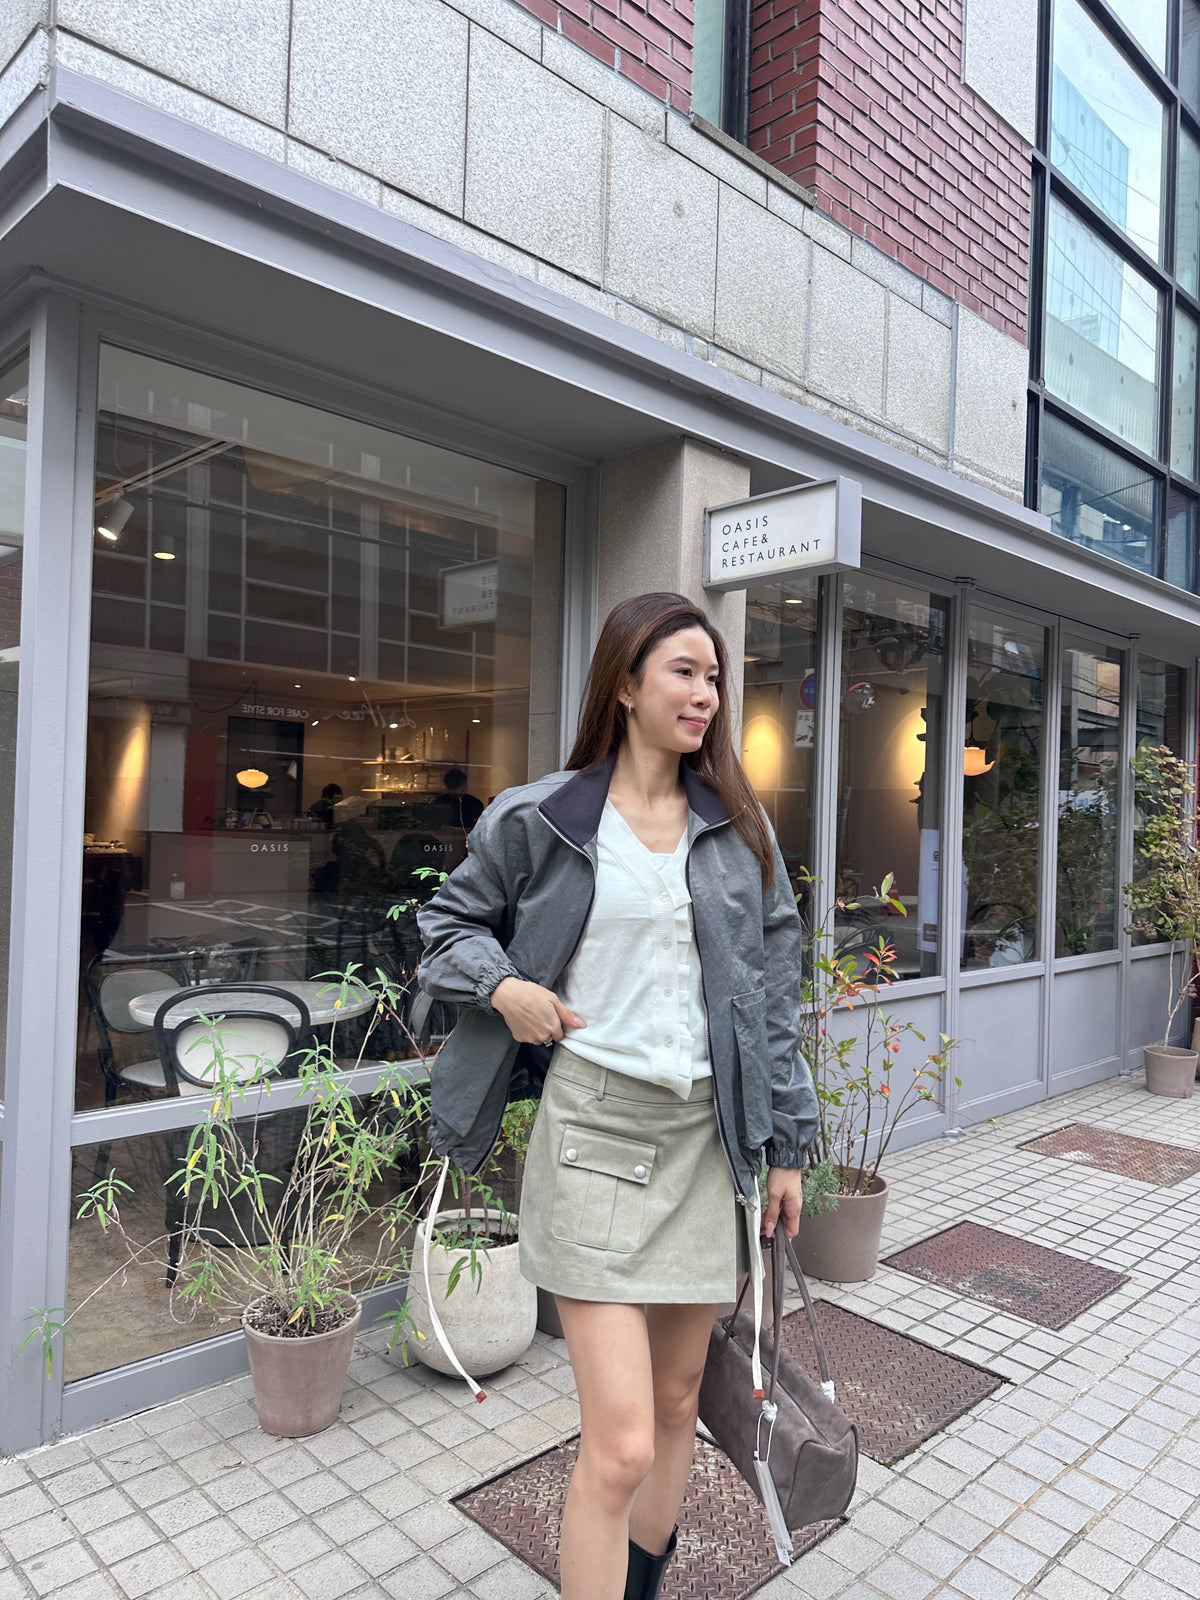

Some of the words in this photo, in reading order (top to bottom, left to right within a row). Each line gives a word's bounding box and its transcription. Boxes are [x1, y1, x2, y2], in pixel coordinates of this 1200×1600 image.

[722, 515, 768, 536] OASIS
[722, 533, 769, 553] CAFE&
[721, 539, 821, 569] RESTAURANT
[250, 843, 289, 853] OASIS
[423, 844, 453, 852] OASIS
